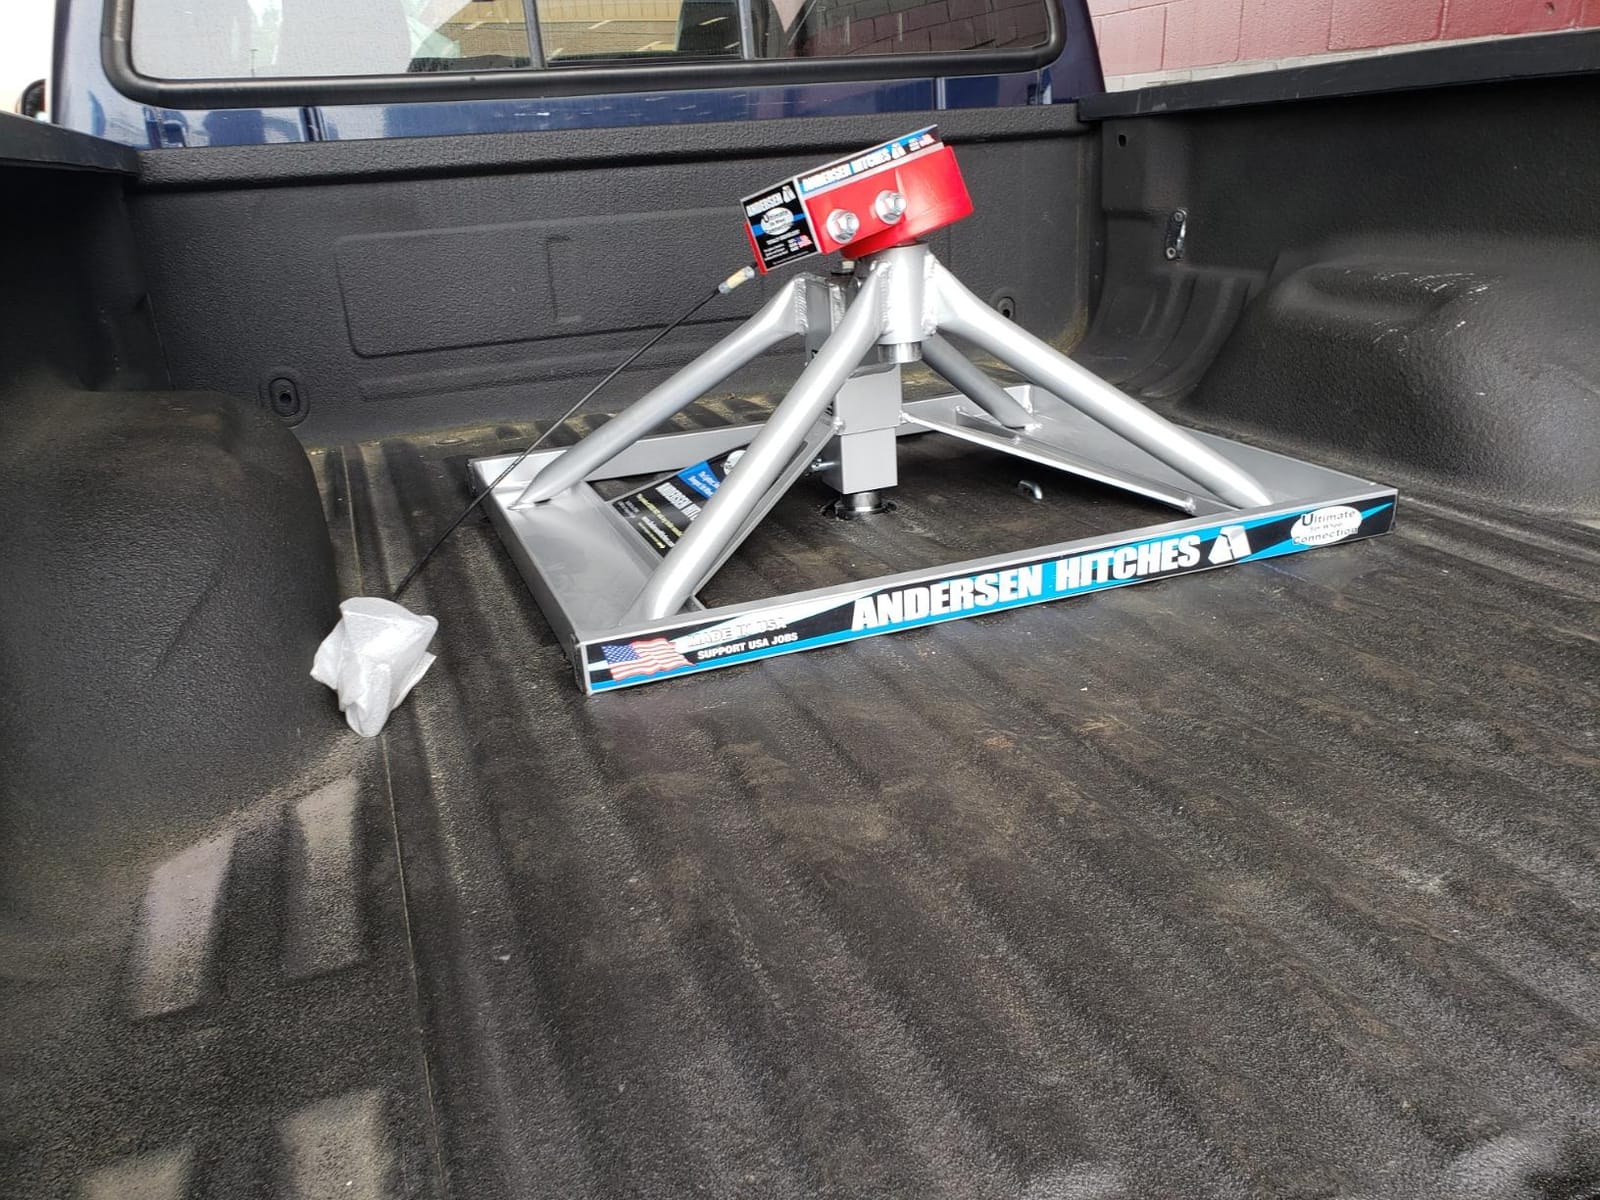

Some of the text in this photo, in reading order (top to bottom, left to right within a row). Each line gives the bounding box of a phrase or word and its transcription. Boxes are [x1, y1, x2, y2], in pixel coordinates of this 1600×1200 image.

[850, 148, 892, 174] HITCHES
[746, 192, 784, 217] ANDERSEN
[655, 481, 693, 510] ANDERSEN
[1302, 511, 1356, 526] Ultimate
[1294, 527, 1359, 545] Connection
[851, 565, 1042, 631] ANDERSEN
[1055, 535, 1201, 592] HITCHES
[688, 627, 734, 647] MADE
[697, 632, 799, 660] SUPPORT USA JOBS
